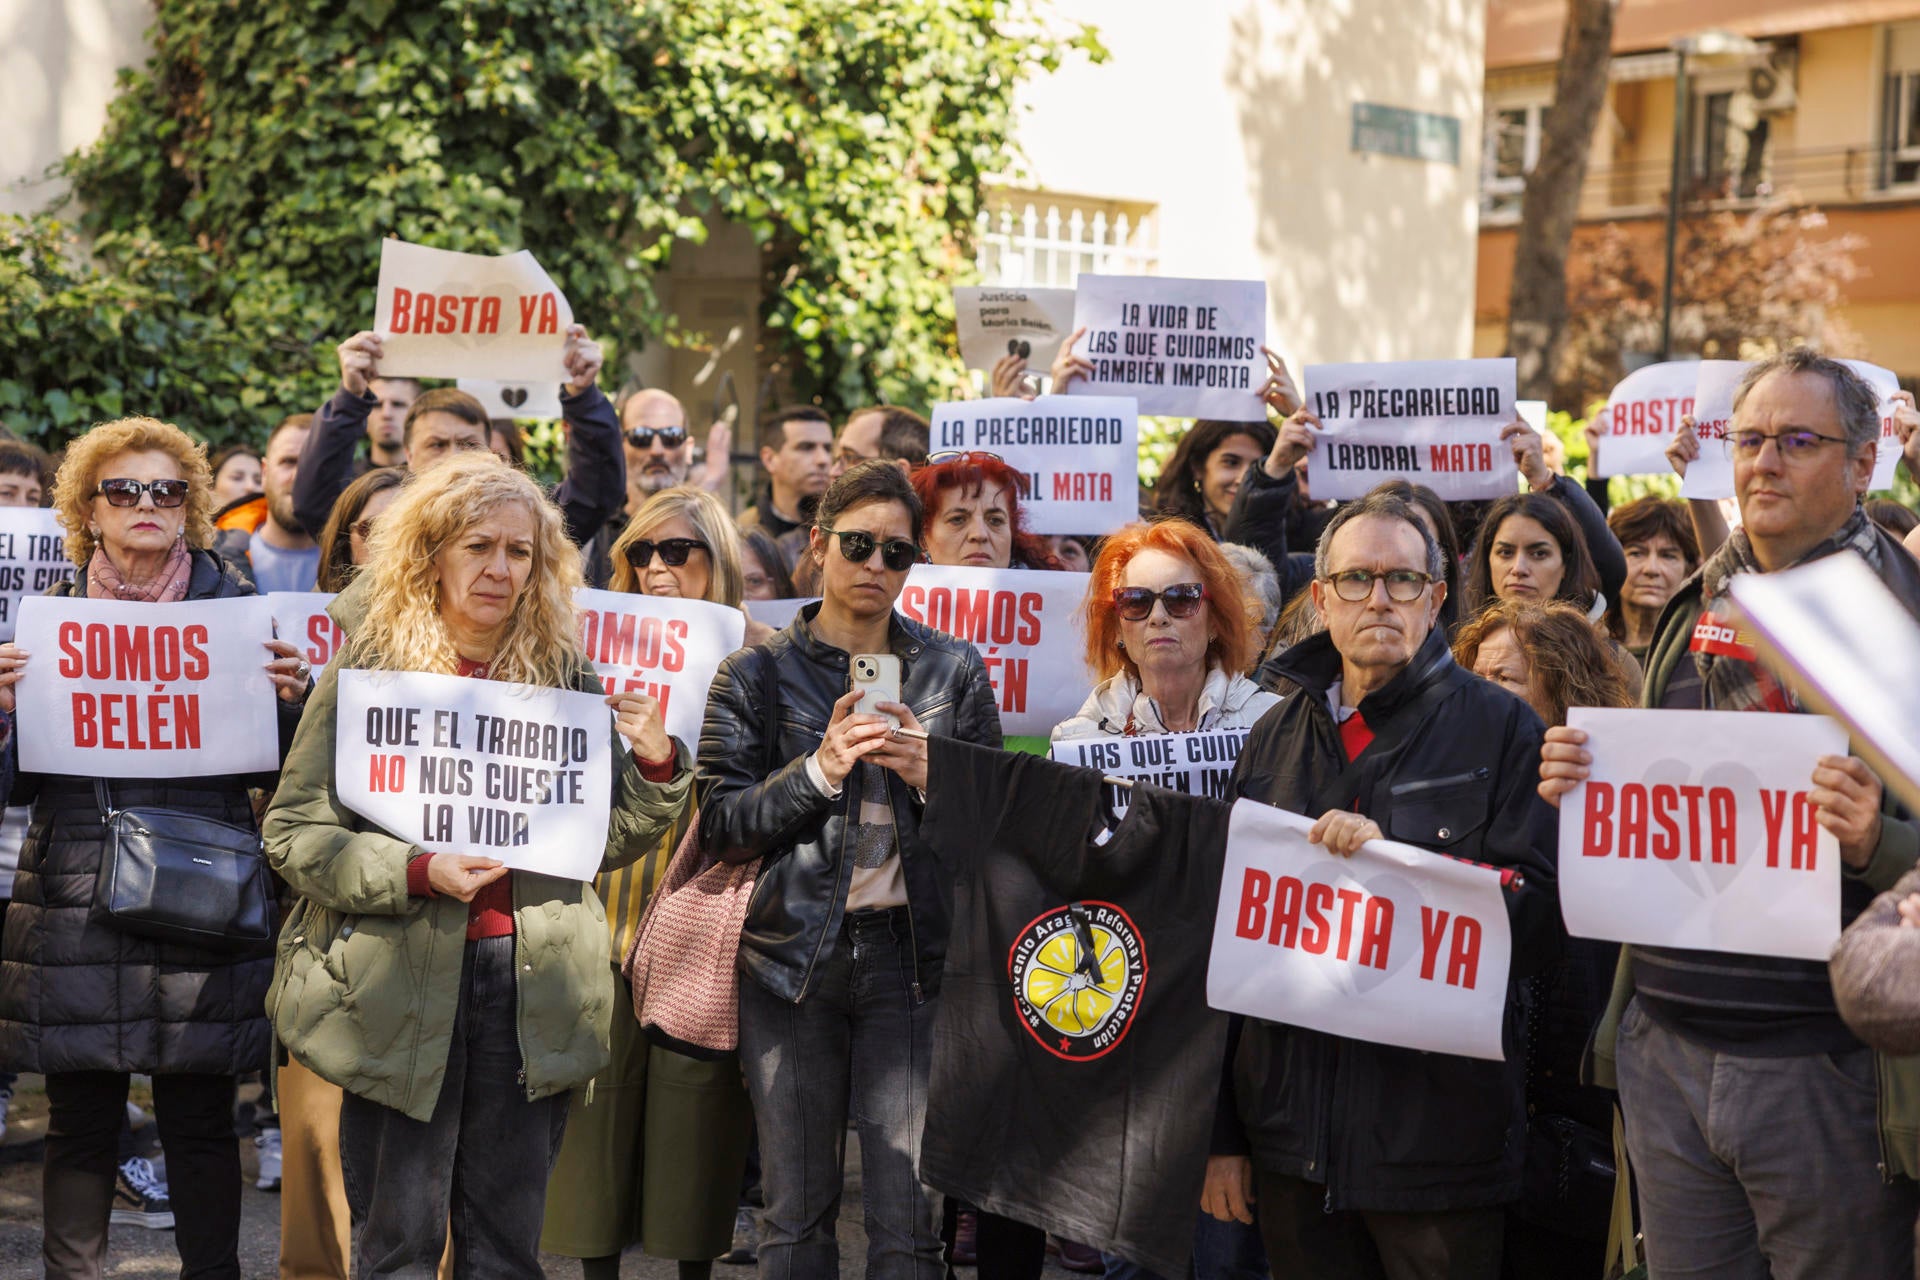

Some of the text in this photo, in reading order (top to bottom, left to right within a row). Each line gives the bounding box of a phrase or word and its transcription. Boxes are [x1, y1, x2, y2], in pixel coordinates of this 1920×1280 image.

[389, 287, 559, 336] BASTA YA
[979, 291, 1028, 302] Justicia
[979, 307, 1010, 317] para
[1121, 303, 1218, 331] LA VIDA DE
[1088, 330, 1255, 360] LAS QUE CUIDAMOS
[1090, 354, 1250, 389] TAMBIÉN IMPORTA
[1315, 386, 1501, 419] LA PRECARIEDAD
[1612, 397, 1696, 436] BASTA
[942, 417, 1122, 446] LA PRECARIEDAD
[1326, 443, 1493, 472] LABORAL MATA
[1053, 472, 1113, 502] MATA
[0, 566, 25, 592] OS
[58, 621, 210, 682] SOMOS
[576, 609, 689, 673] OMOS
[71, 684, 201, 750] BELÉN
[366, 706, 588, 768] QUE EL TRABAJO
[1078, 742, 1121, 769] LAS
[1130, 738, 1177, 768] QUE
[369, 754, 585, 805] NO NOS CUESTE
[423, 804, 530, 848] LA VIDA
[1582, 782, 1819, 872] BASTA YA
[1096, 908, 1140, 958] Reforma
[1235, 867, 1483, 990] BASTA YA
[1093, 973, 1143, 1049] Protección
